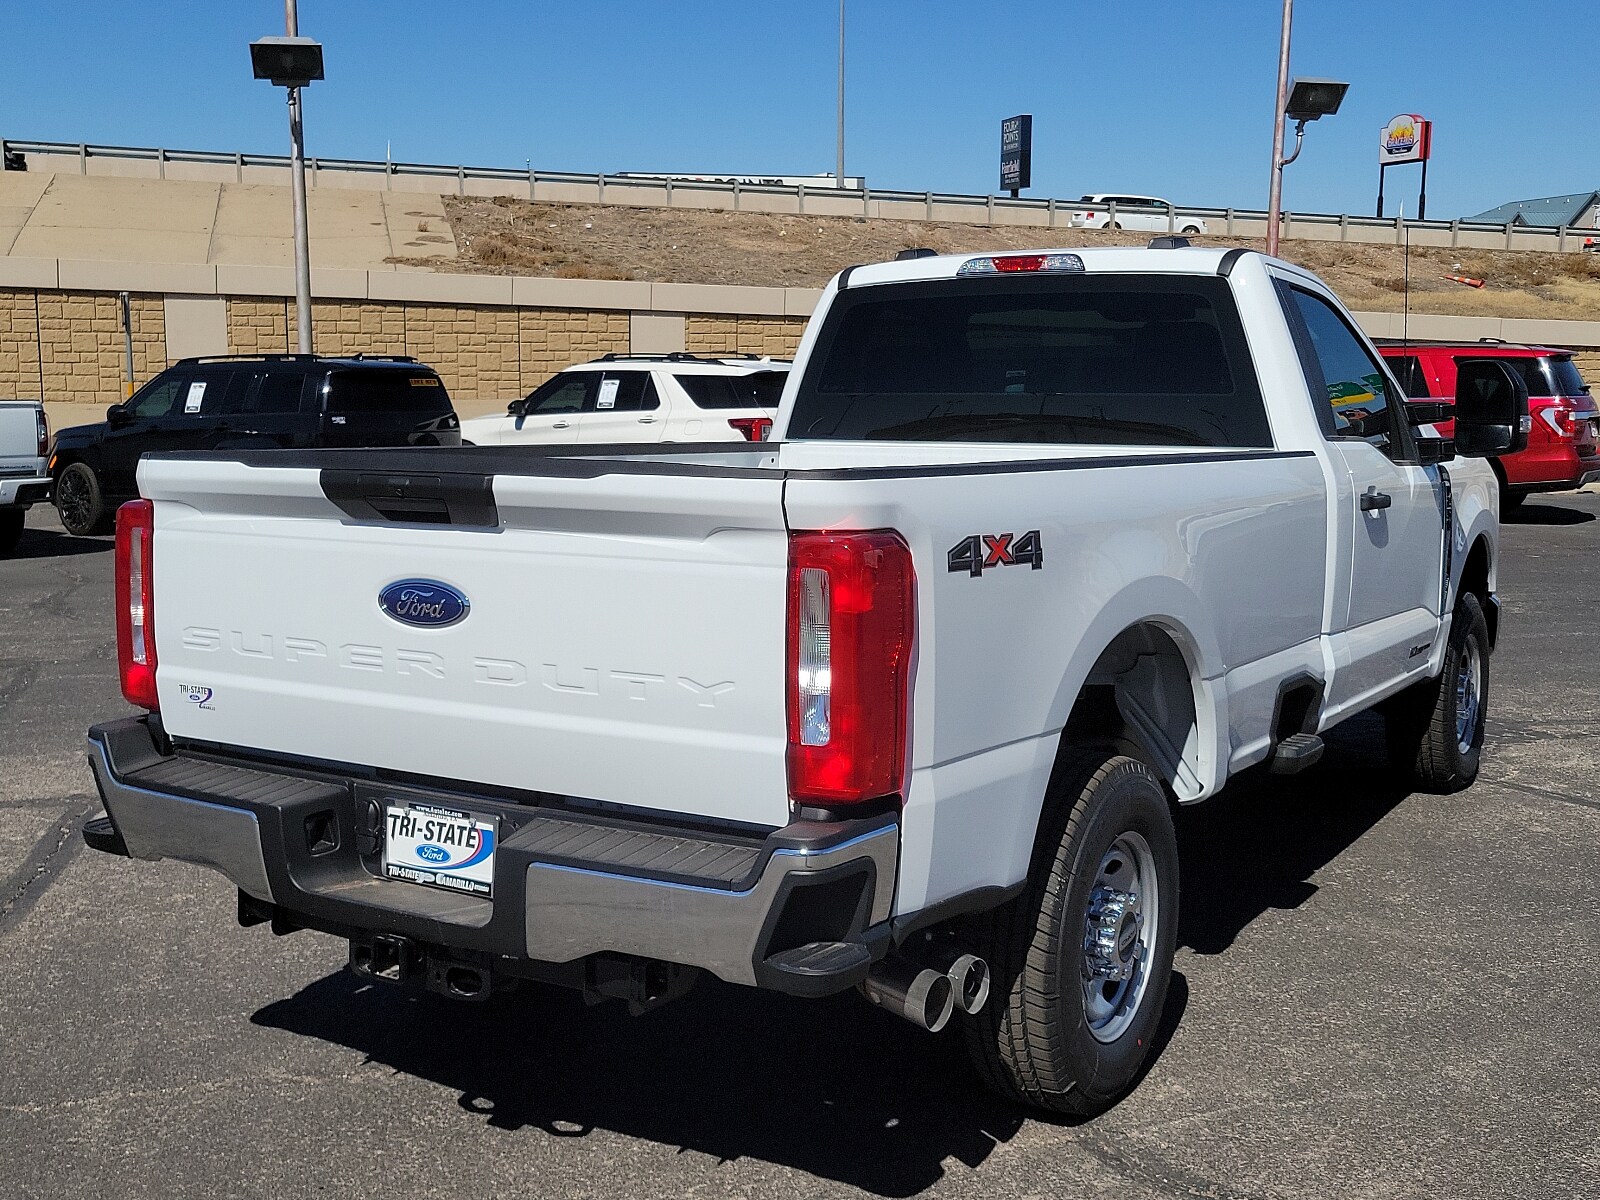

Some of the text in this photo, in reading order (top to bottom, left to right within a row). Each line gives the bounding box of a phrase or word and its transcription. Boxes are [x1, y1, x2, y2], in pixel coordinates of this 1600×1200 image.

[1004, 131, 1019, 144] POINTS
[396, 589, 446, 618] Ford
[183, 626, 735, 707] SUPER DUTY
[179, 684, 207, 695] TRI-STATE
[388, 814, 478, 849] TRI-STATE
[422, 847, 444, 861] Ford
[388, 866, 419, 882] TRI-STATE
